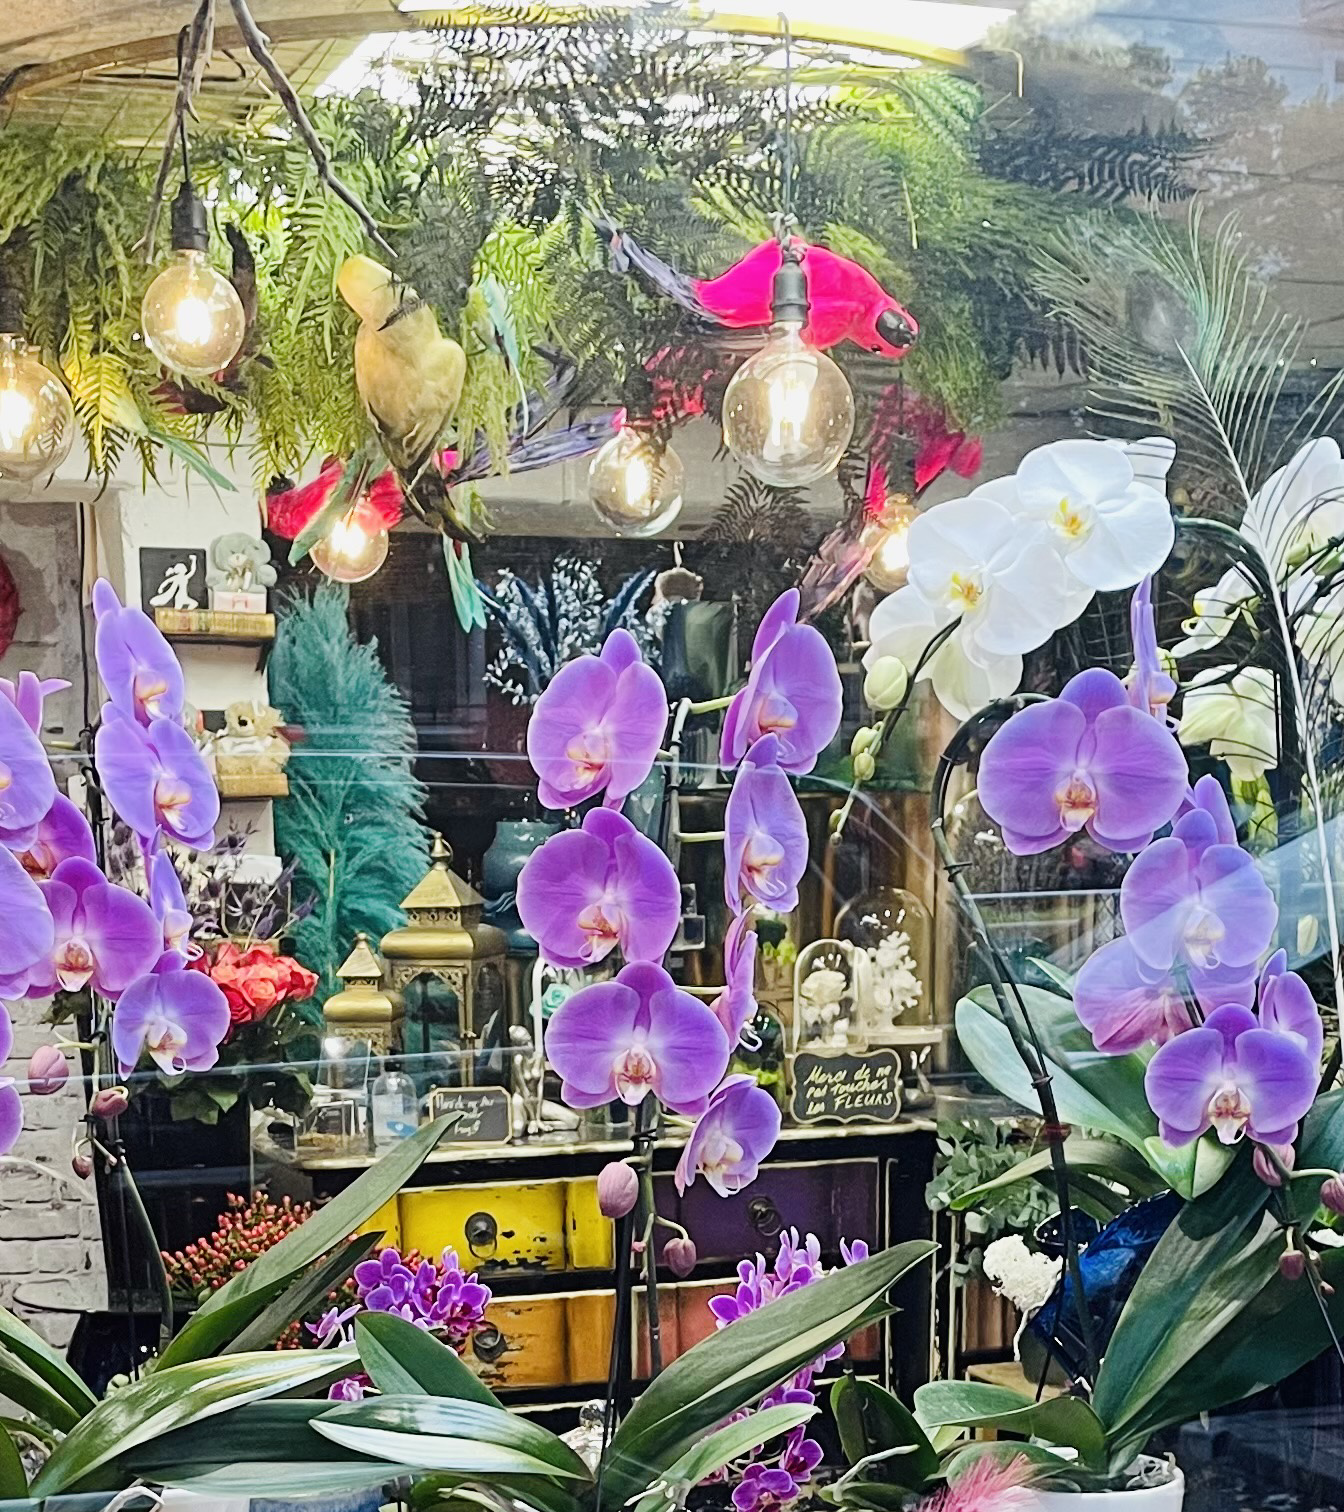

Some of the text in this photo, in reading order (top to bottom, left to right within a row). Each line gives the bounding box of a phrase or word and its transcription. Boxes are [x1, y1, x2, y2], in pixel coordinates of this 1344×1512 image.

[803, 1063, 892, 1086] Merci de ne
[834, 1091, 893, 1111] FLEURS
